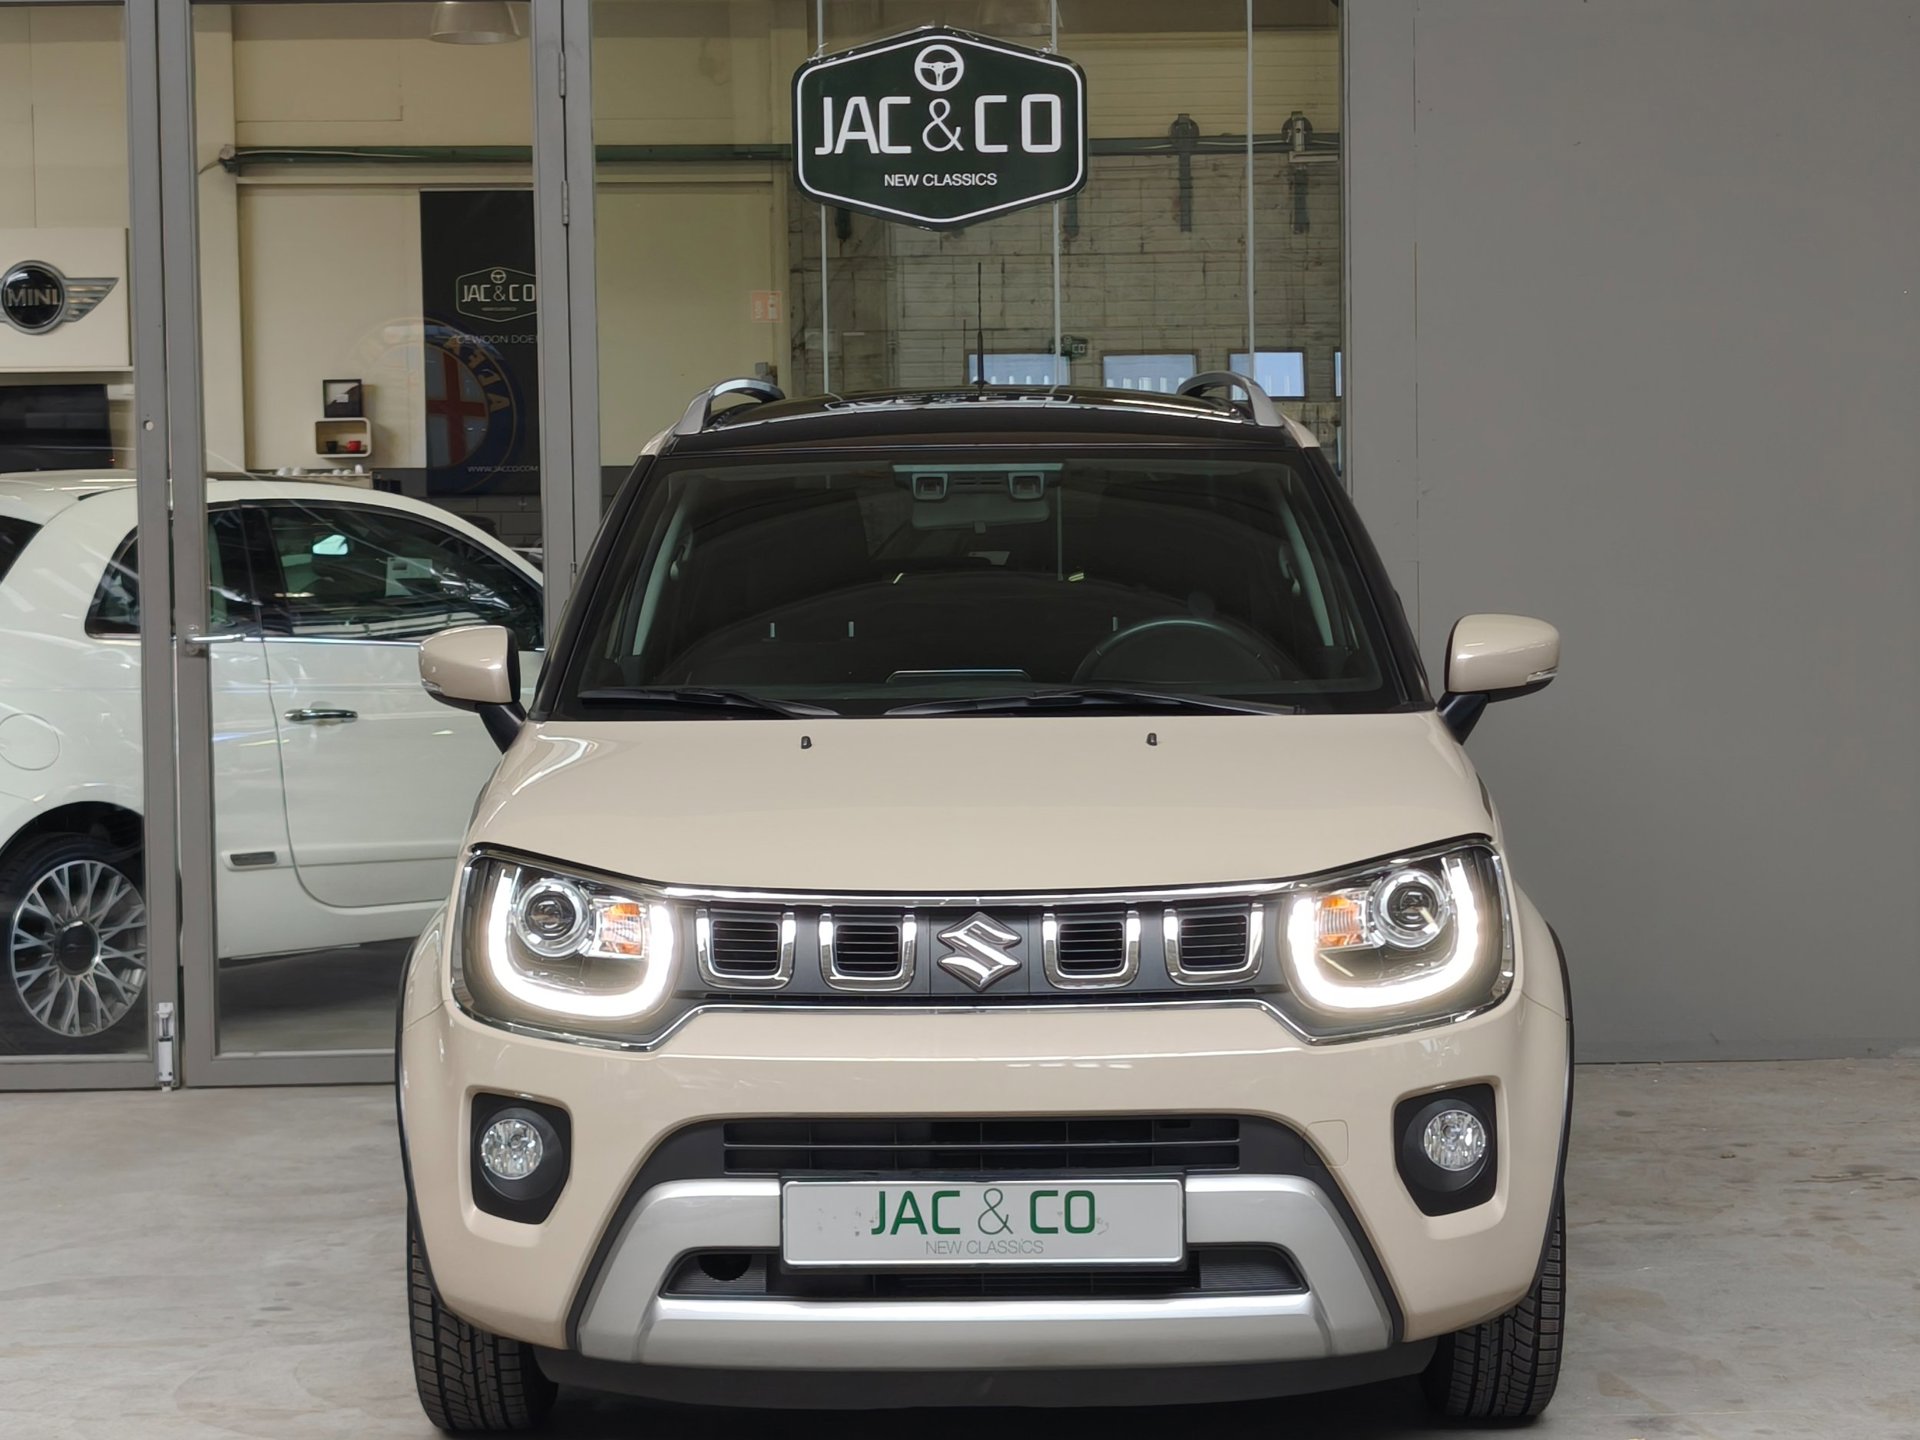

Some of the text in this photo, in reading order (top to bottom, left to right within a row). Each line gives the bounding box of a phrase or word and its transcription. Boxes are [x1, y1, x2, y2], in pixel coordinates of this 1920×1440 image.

[884, 172, 998, 187] NEW CLASSICS
[7, 288, 60, 306] MINI
[511, 334, 537, 344] DOE
[926, 1239, 1044, 1255] NEW CLASSICS
